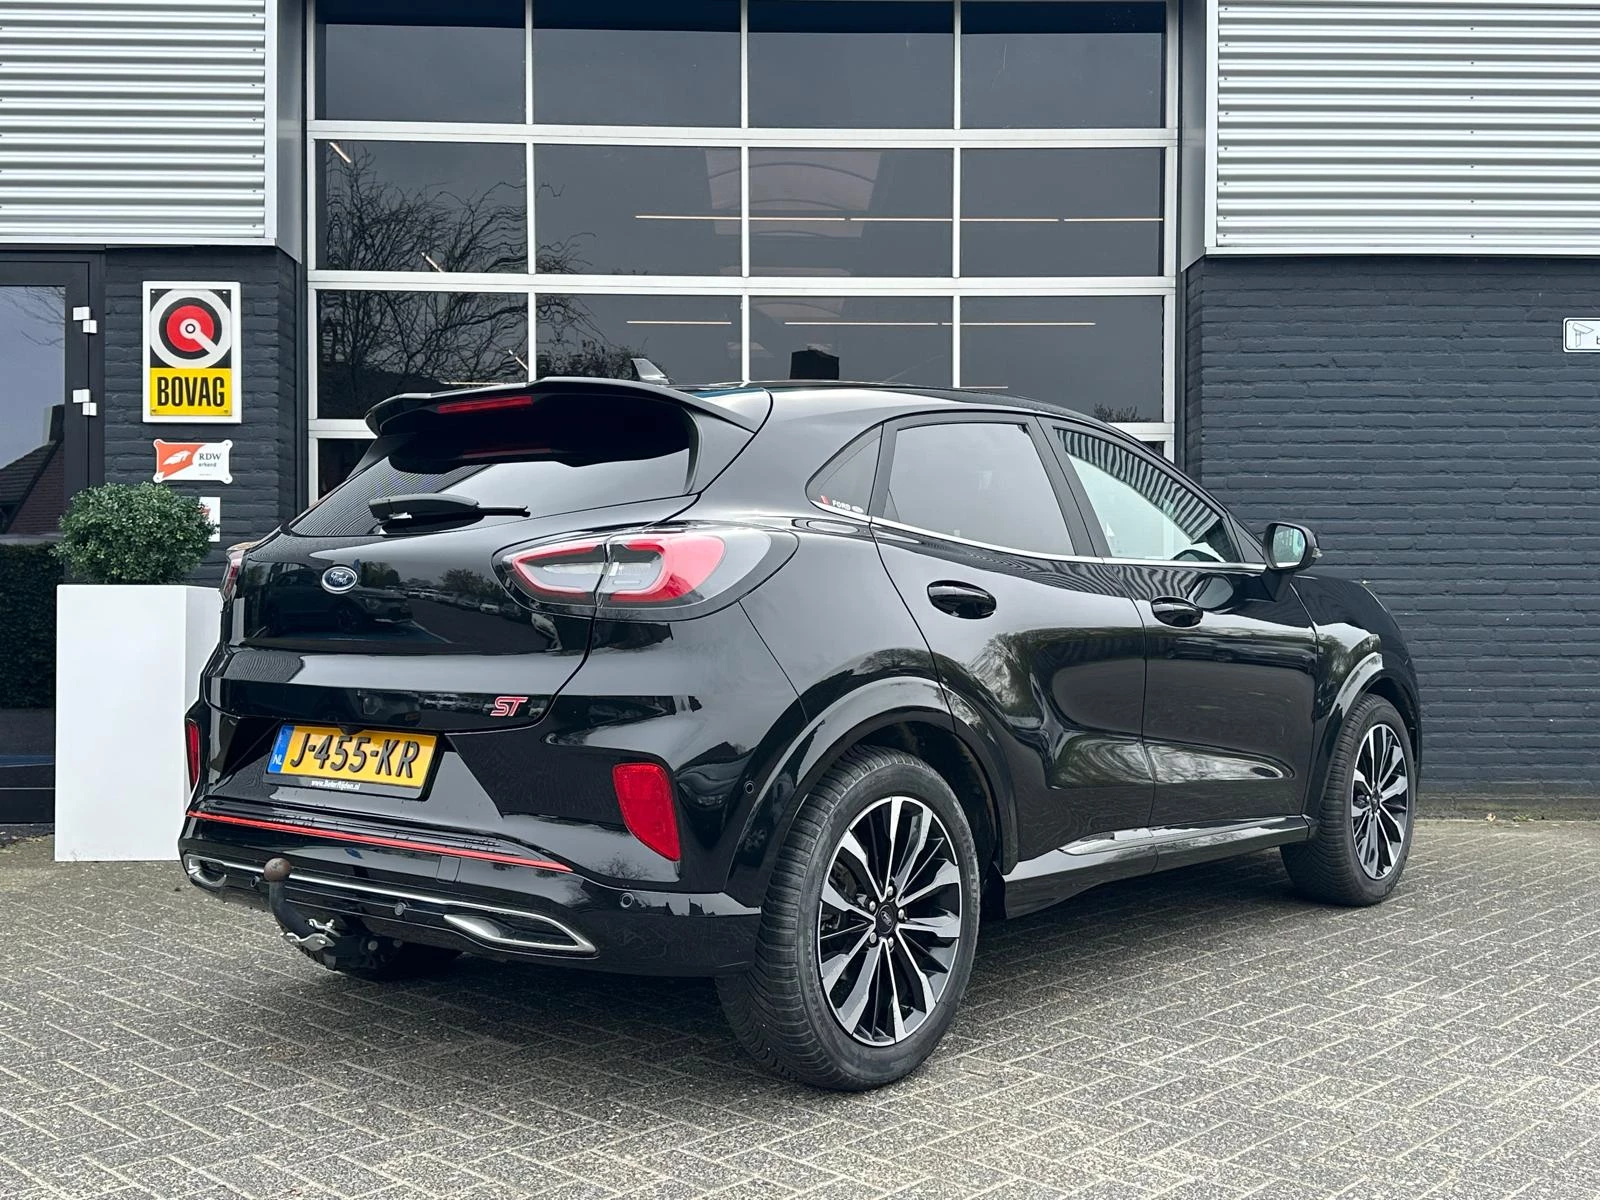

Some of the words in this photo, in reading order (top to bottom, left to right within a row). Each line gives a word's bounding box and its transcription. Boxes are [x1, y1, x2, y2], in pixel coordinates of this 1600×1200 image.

[157, 376, 225, 407] BOVAG
[199, 453, 221, 461] RDW
[832, 500, 851, 511] FORD
[490, 696, 529, 717] ST
[272, 754, 283, 765] NL
[290, 733, 420, 779] J-455-KR
